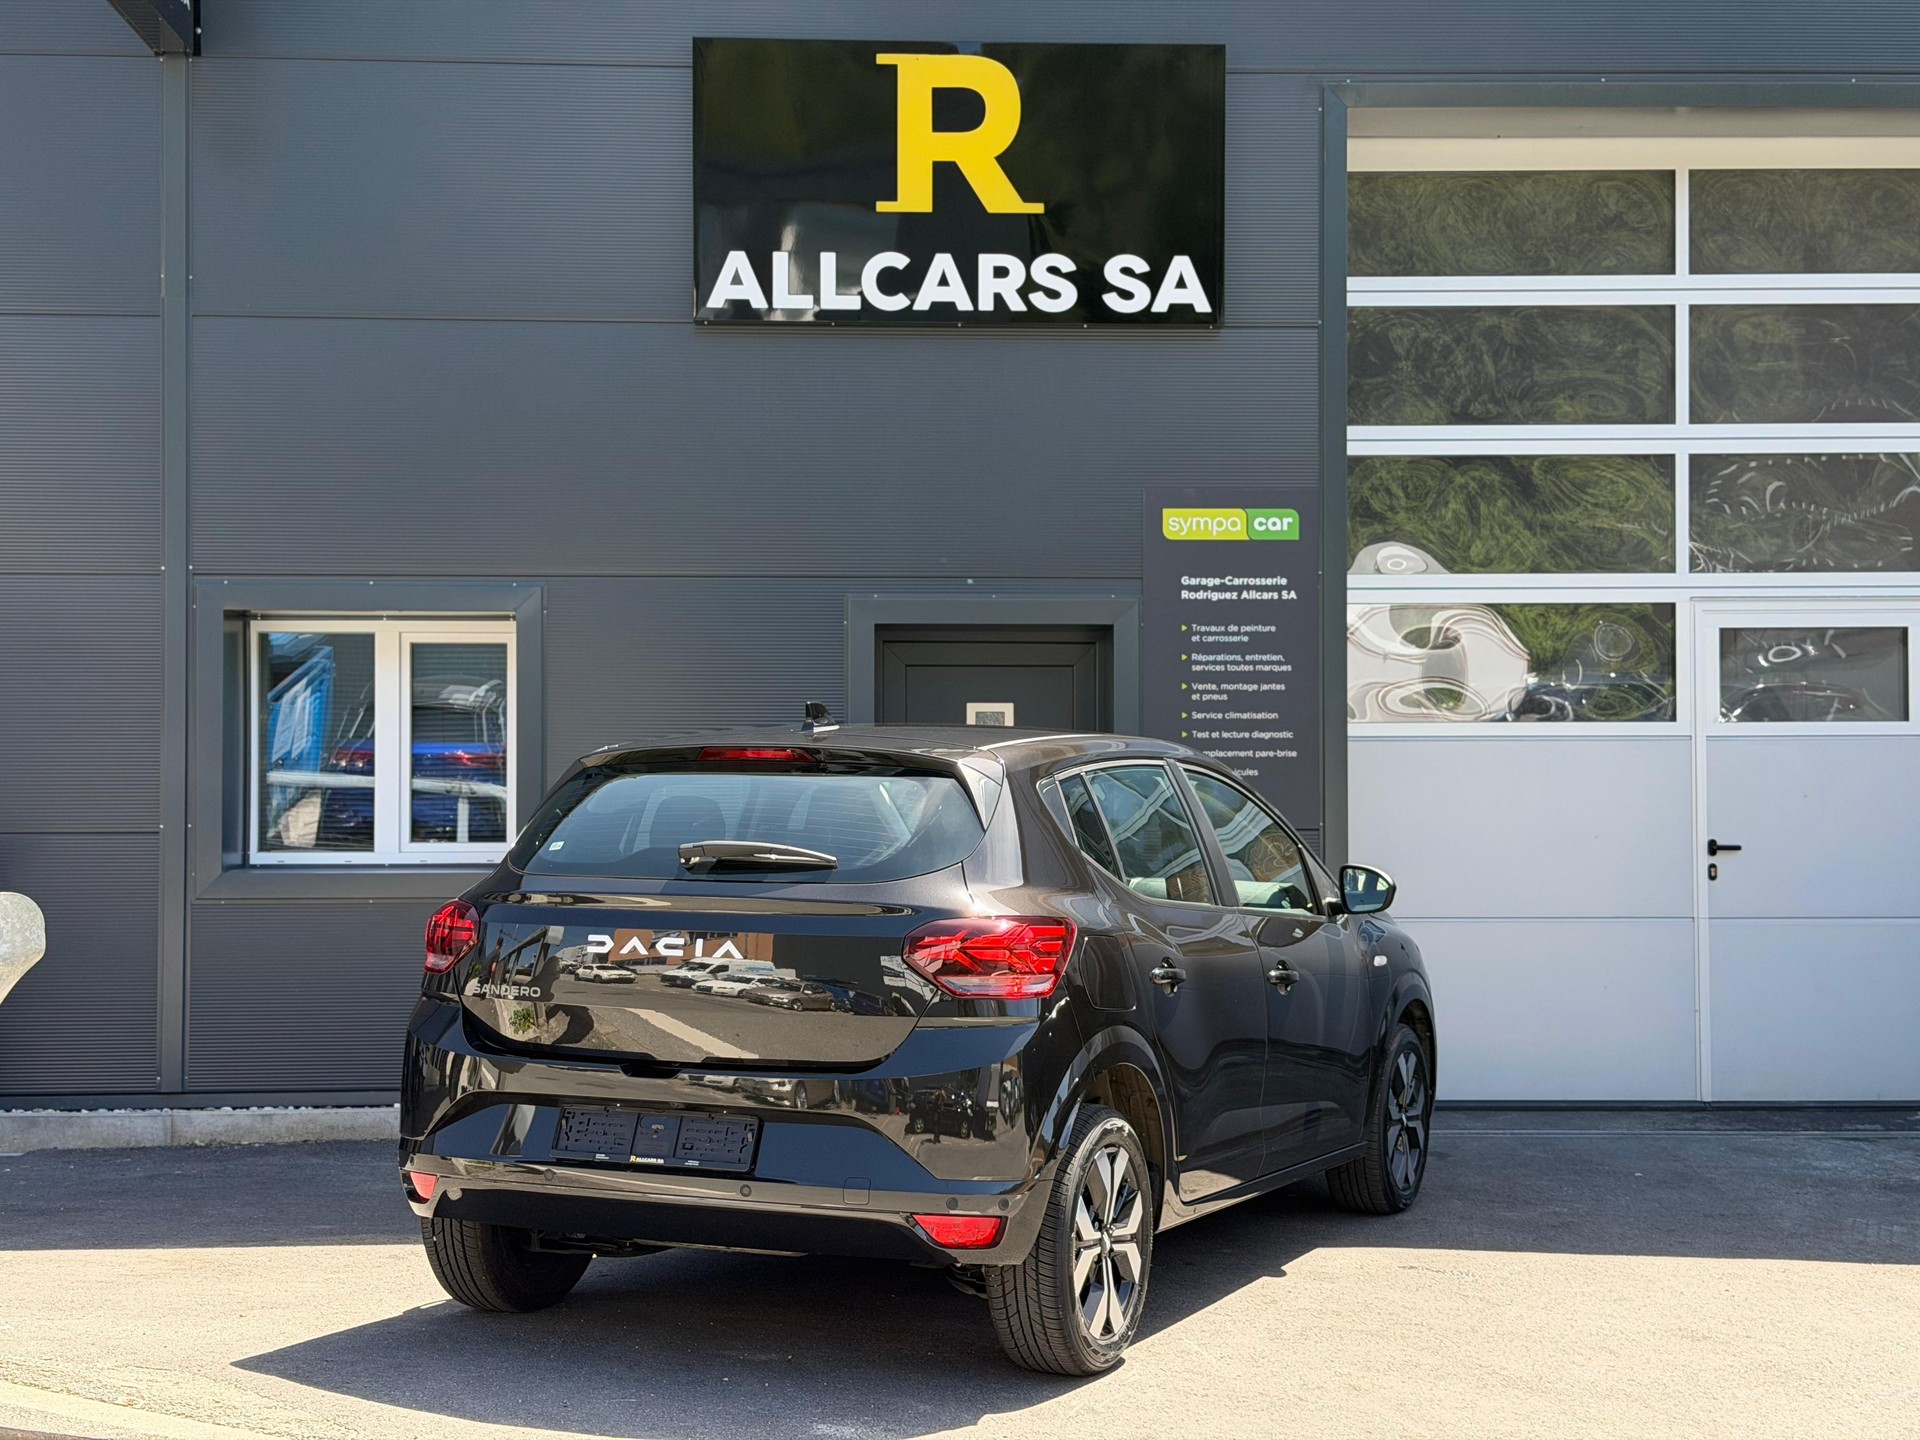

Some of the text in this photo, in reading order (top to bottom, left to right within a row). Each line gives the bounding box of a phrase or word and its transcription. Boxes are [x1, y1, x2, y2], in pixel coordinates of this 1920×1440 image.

[875, 53, 1045, 213] R
[706, 250, 1213, 314] ALLCARS SA
[1168, 516, 1294, 536] sympa car
[1180, 575, 1288, 587] Garage-Carrosserie
[1180, 590, 1298, 601] Rodriguez Allcars SA
[1191, 624, 1277, 635] Travaux de peinture
[1191, 634, 1249, 642] et carrosserie
[1191, 653, 1285, 662] Réparations, entretien,
[1255, 664, 1292, 673] marques
[1191, 682, 1286, 692] Vente, montage jantes
[1191, 693, 1228, 702] et pneus
[1191, 711, 1279, 719] Service climatisation
[1191, 730, 1294, 739] Test et lecture diagnostic
[1255, 748, 1298, 759] pare-brise
[586, 934, 744, 960] DACIA
[472, 983, 541, 998] SANDERO
